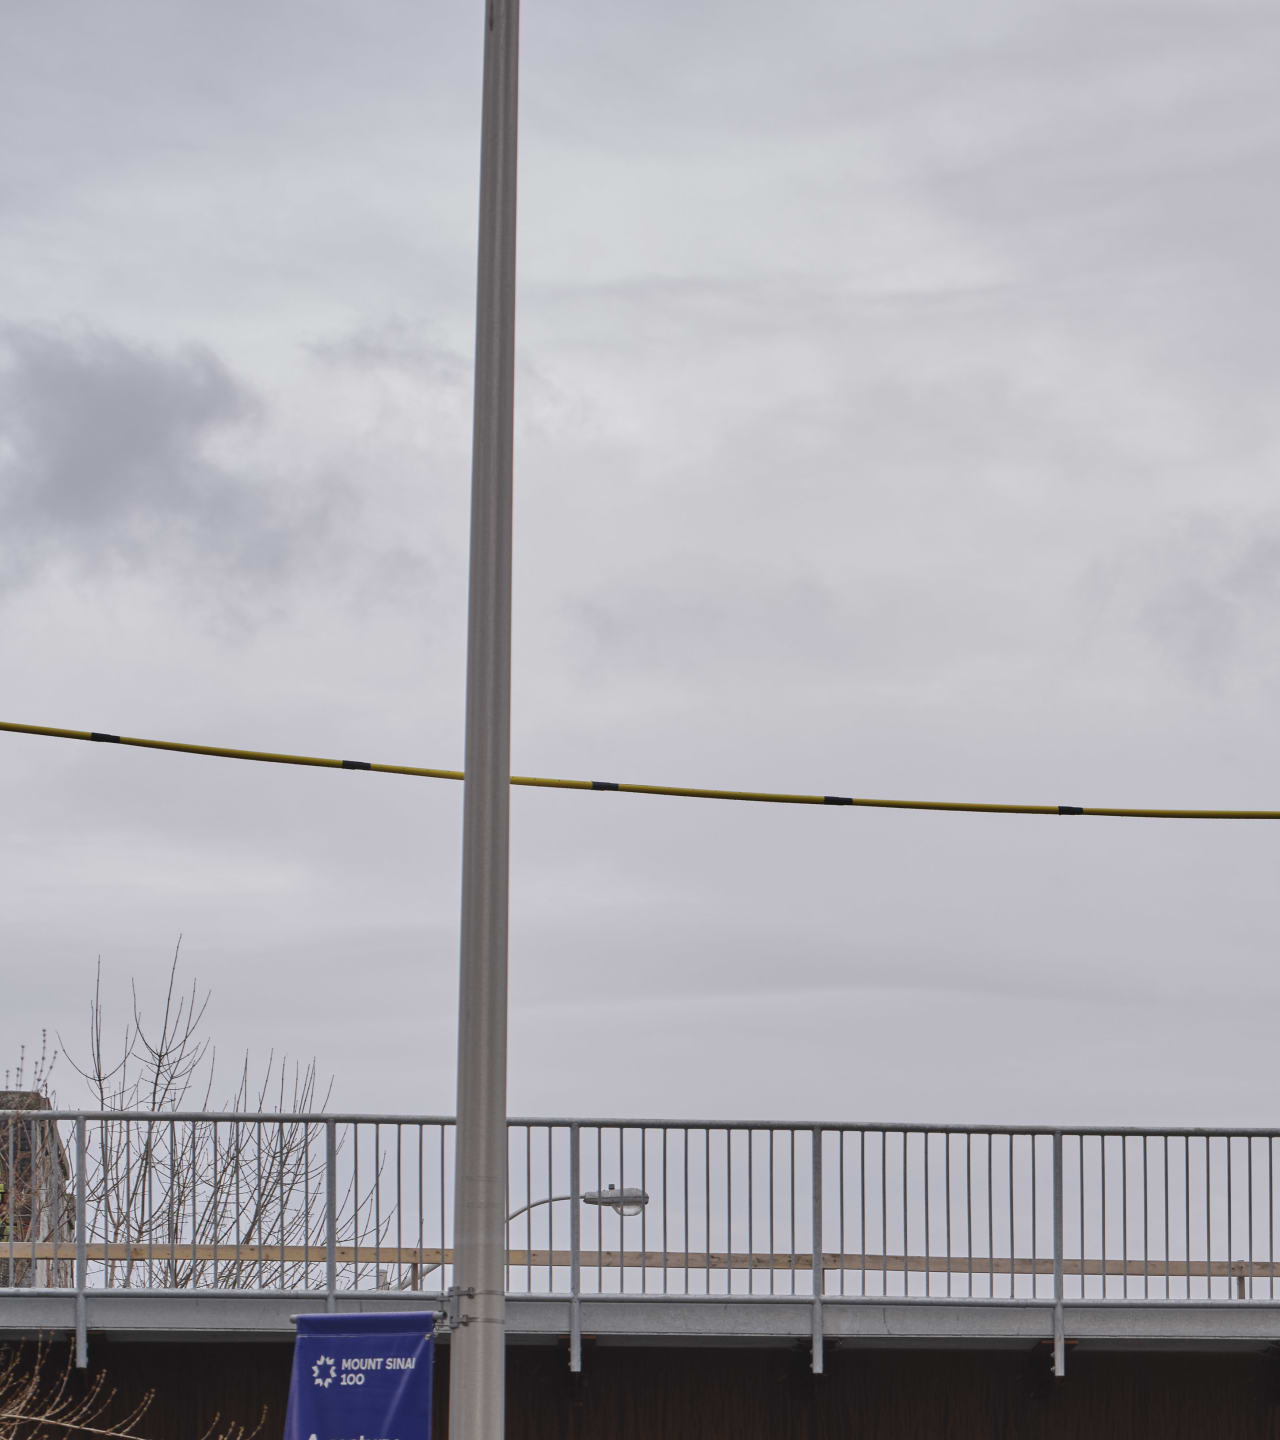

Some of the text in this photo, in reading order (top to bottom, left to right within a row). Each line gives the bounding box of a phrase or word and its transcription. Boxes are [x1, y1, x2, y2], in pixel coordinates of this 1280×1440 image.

[341, 1357, 416, 1370] MOUNT SINAI
[340, 1373, 365, 1386] 100
